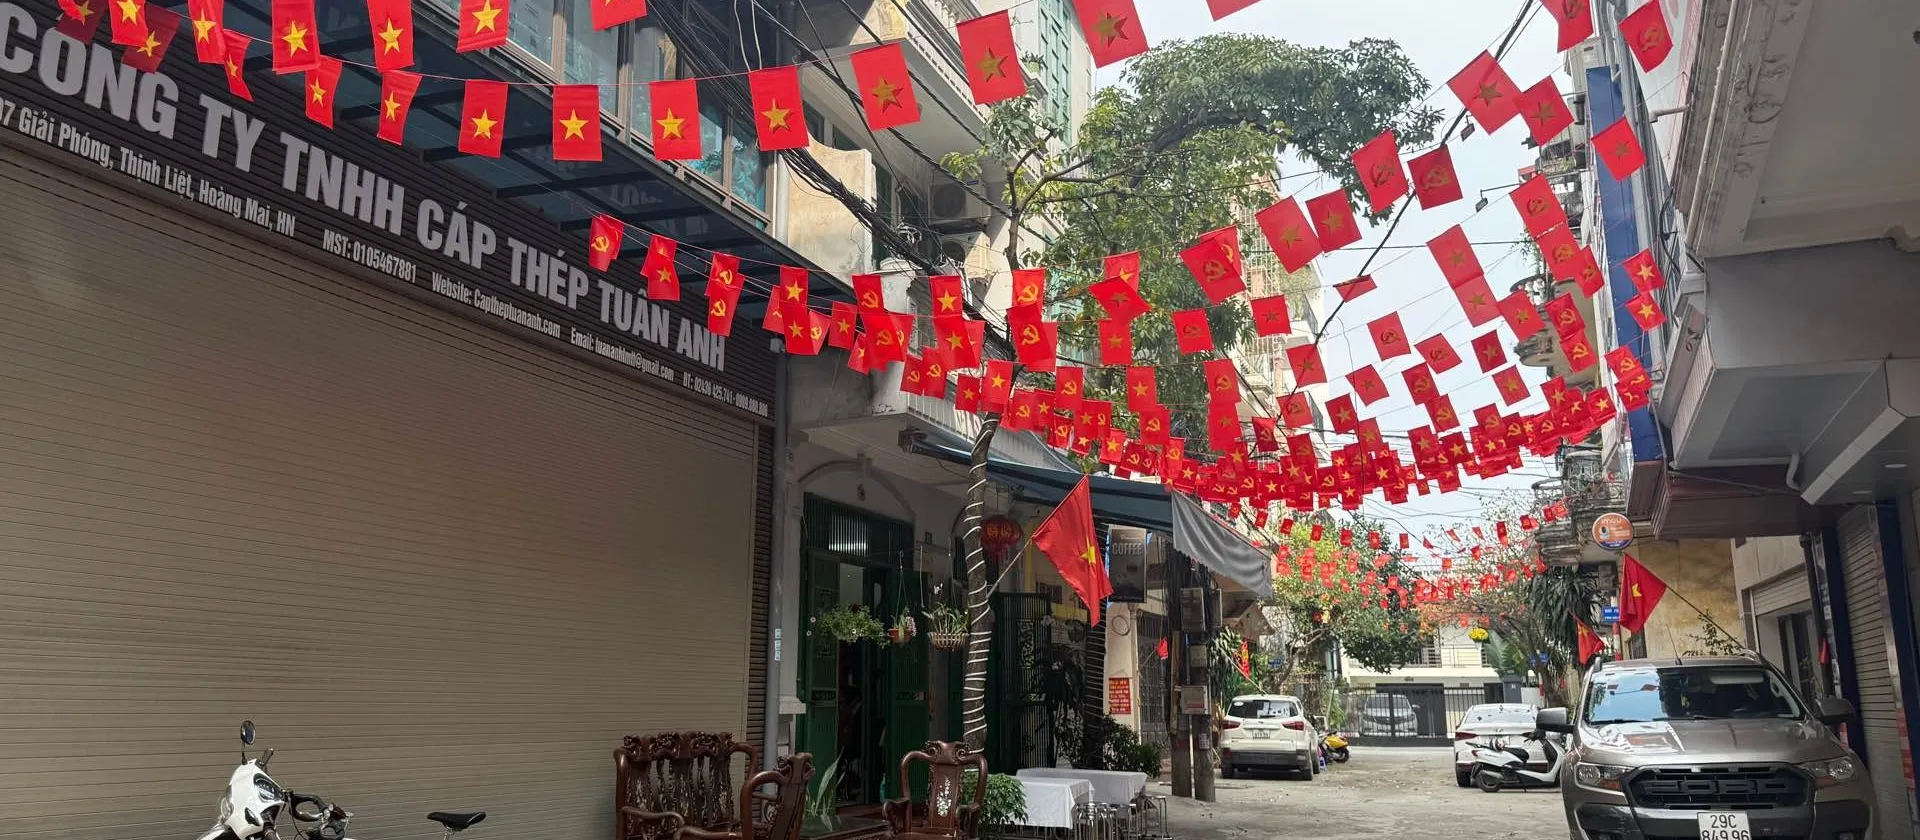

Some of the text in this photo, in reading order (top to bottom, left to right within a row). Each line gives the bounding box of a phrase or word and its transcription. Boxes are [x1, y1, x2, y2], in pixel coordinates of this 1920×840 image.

[18, 106, 55, 143] Giải
[120, 146, 162, 185] Thịnh
[199, 179, 242, 219] Hoàng
[244, 198, 273, 231] Mai,
[276, 210, 296, 237] HN
[322, 228, 352, 259] MST:
[353, 241, 417, 283] 0105467881
[432, 271, 473, 305] Website:
[570, 326, 594, 351] Email:
[200, 92, 265, 173] TY
[280, 131, 405, 236] TNHH
[417, 199, 497, 270] CÁP
[508, 236, 589, 310] THÉP
[676, 317, 725, 372] ANH
[1112, 543, 1143, 556] COFFEE
[1710, 814, 1737, 828] 29C
